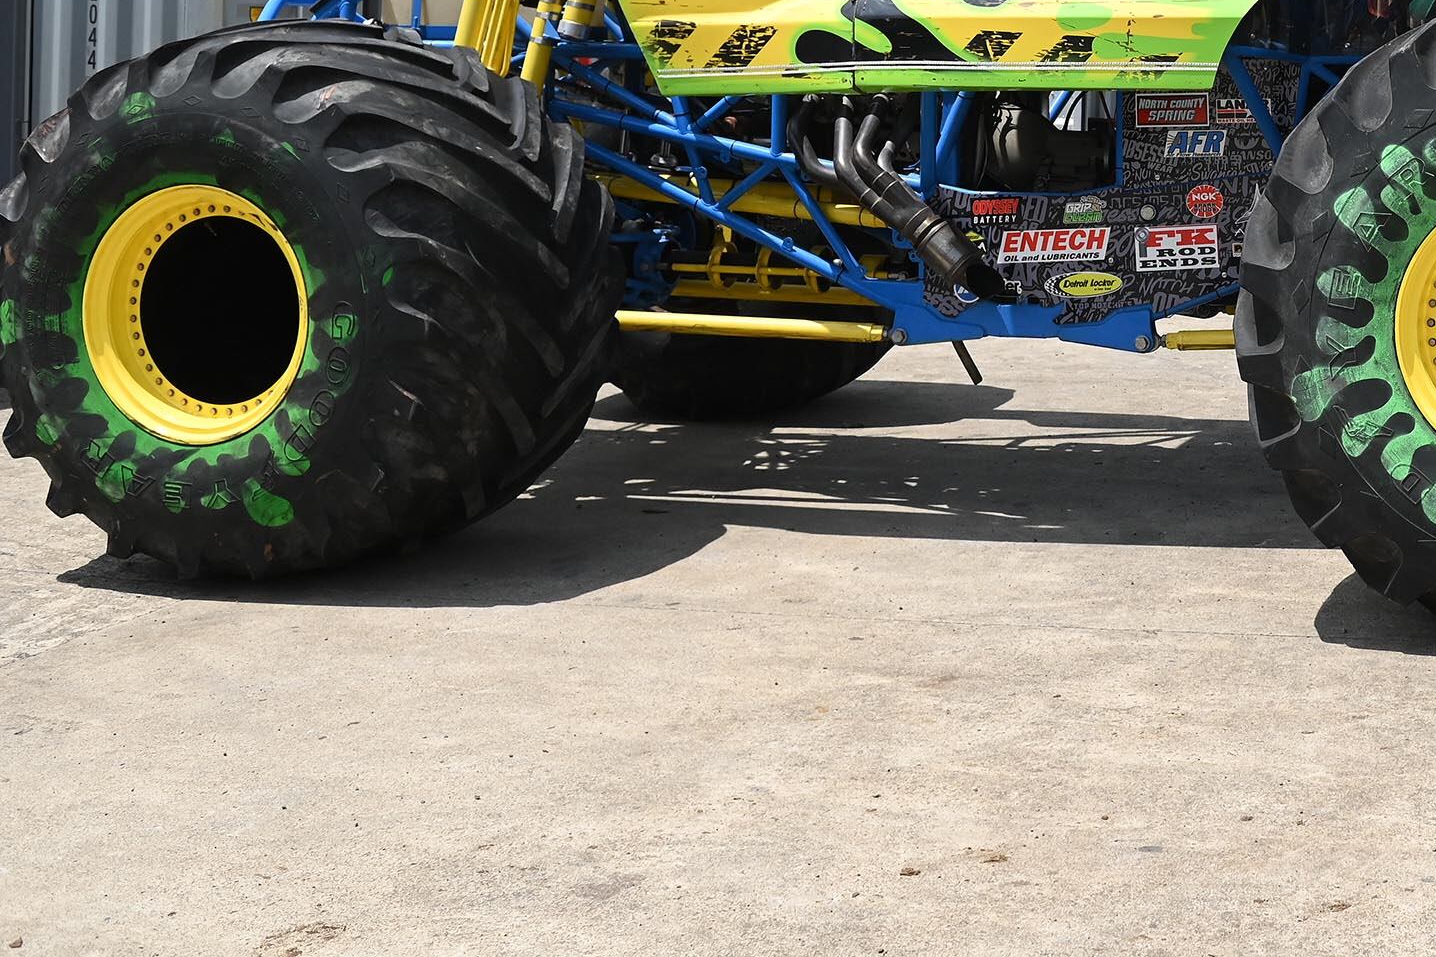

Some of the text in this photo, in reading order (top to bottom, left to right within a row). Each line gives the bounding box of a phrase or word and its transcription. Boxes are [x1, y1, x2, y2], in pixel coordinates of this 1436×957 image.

[1138, 97, 1206, 110] NORTH COUNTY
[1148, 110, 1196, 121] SPRING
[1168, 131, 1225, 153] AFR
[1192, 193, 1216, 201] NGK
[972, 198, 1019, 215] ODYSSEY
[1066, 202, 1091, 213] GRIP
[973, 215, 1017, 224] BATTERY
[1003, 229, 1106, 253] ENTECH
[1145, 228, 1216, 247] FK
[1004, 253, 1020, 262] OIL
[1042, 252, 1100, 261] LUBRICANTS
[1156, 247, 1216, 257] ROD
[1139, 257, 1217, 268] ENDS
[1063, 279, 1115, 288] Detroit Locker
